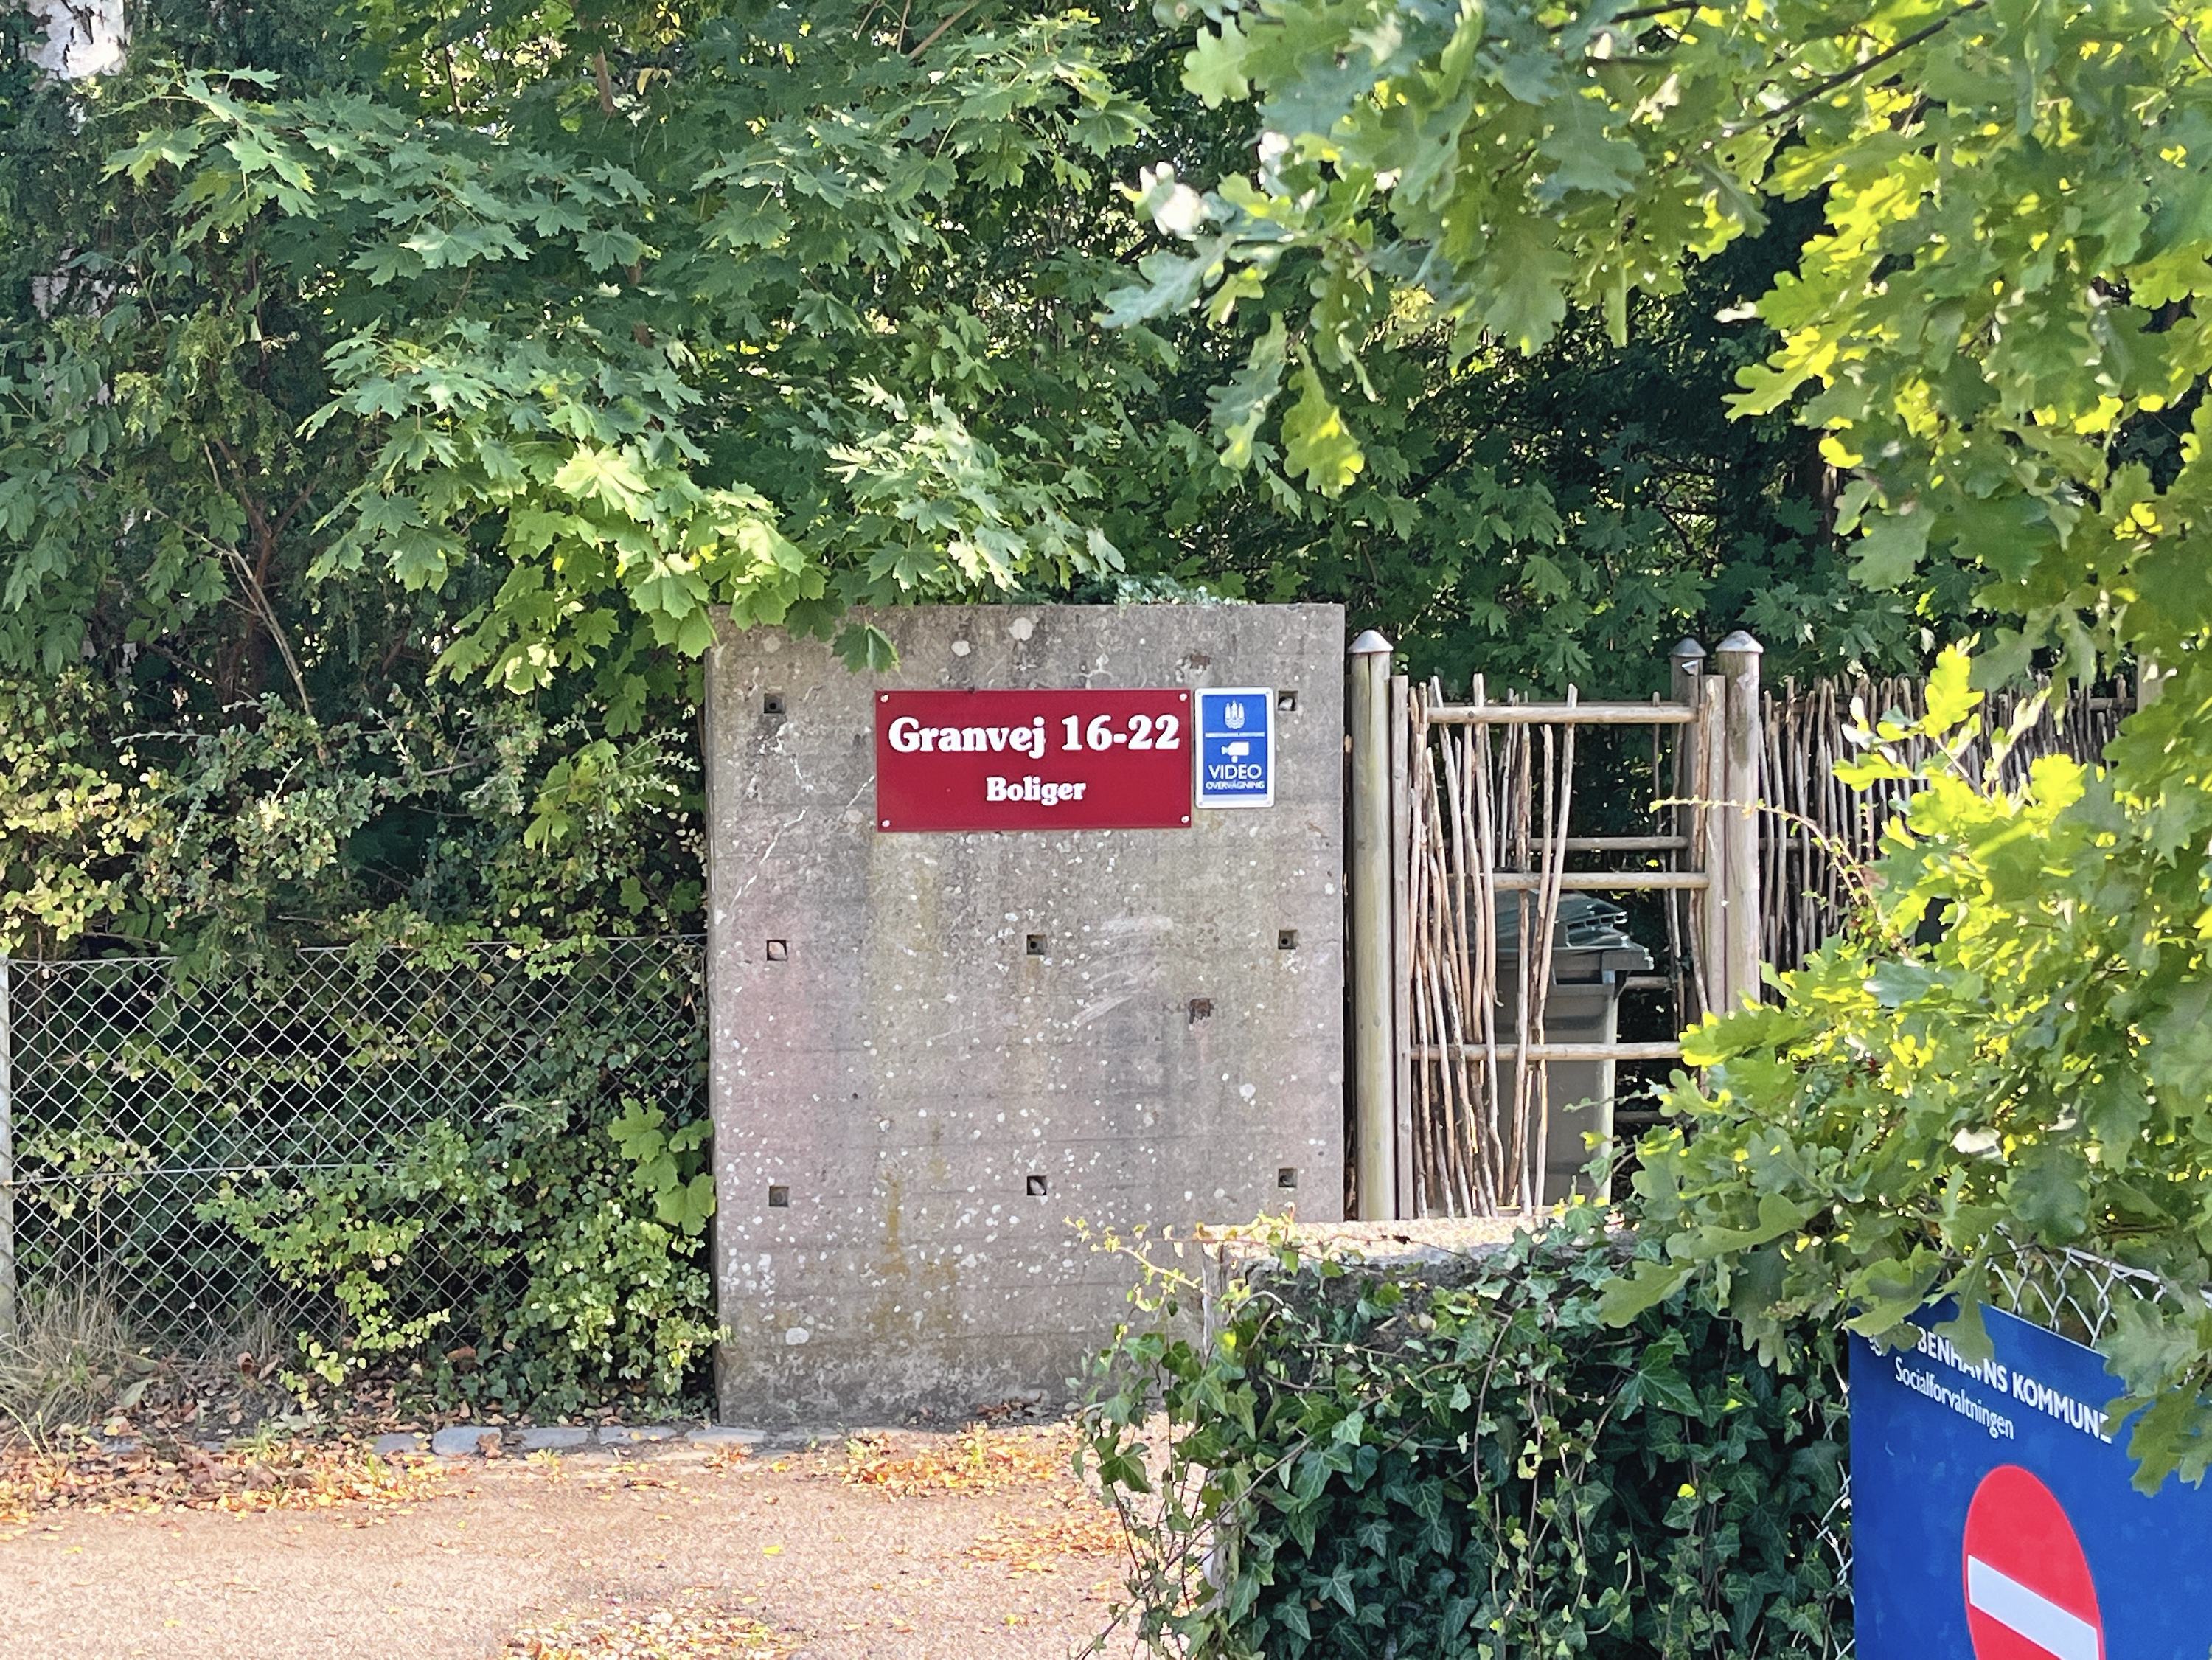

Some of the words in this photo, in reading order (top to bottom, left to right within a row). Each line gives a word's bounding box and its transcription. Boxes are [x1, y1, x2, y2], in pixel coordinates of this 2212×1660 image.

[889, 716, 1045, 759] Granvej
[1062, 715, 1180, 751] 16-22
[1208, 763, 1262, 780] VIDEO
[987, 776, 1086, 806] Boliger
[1895, 1356, 2014, 1440] Socialforvaltningen
